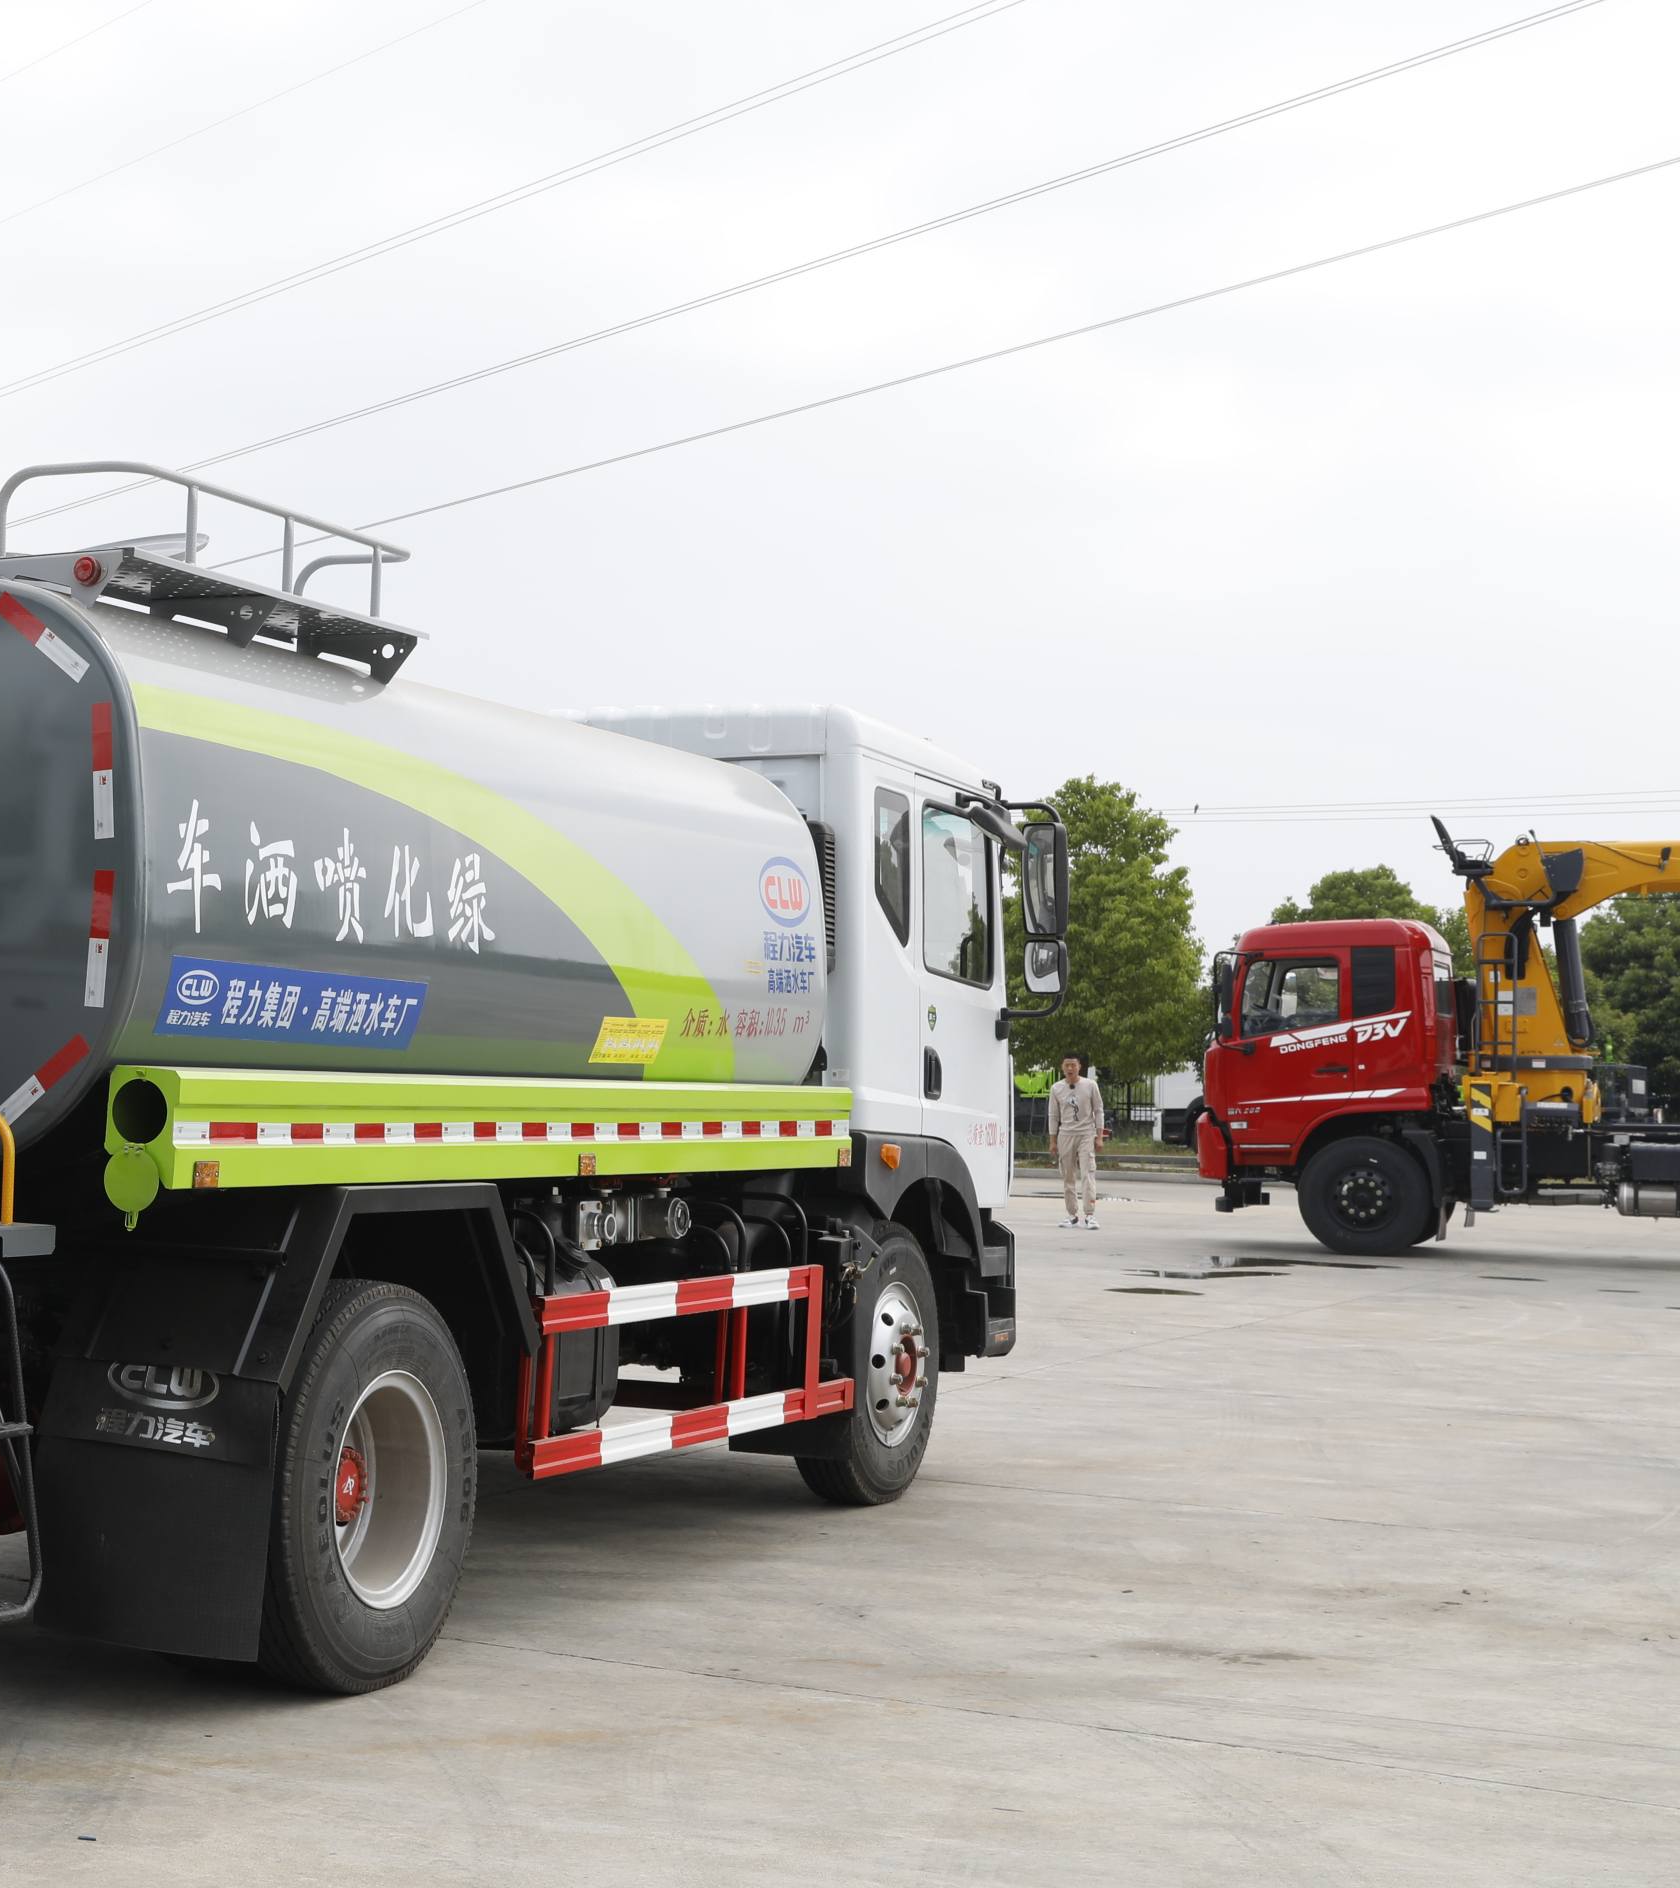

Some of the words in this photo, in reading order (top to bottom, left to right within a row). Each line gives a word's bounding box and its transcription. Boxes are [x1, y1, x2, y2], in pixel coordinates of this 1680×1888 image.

[764, 876, 803, 911] CLW
[763, 931, 816, 962] 程力汽车
[181, 978, 214, 997] CLW
[767, 968, 815, 993] 高端洒水车厂
[166, 1009, 212, 1027] 程力汽车
[1280, 1034, 1347, 1054] DONGFENG
[1353, 1018, 1407, 1043] D3V
[121, 1365, 203, 1398] CLW
[96, 1407, 213, 1448] 程力汽车
